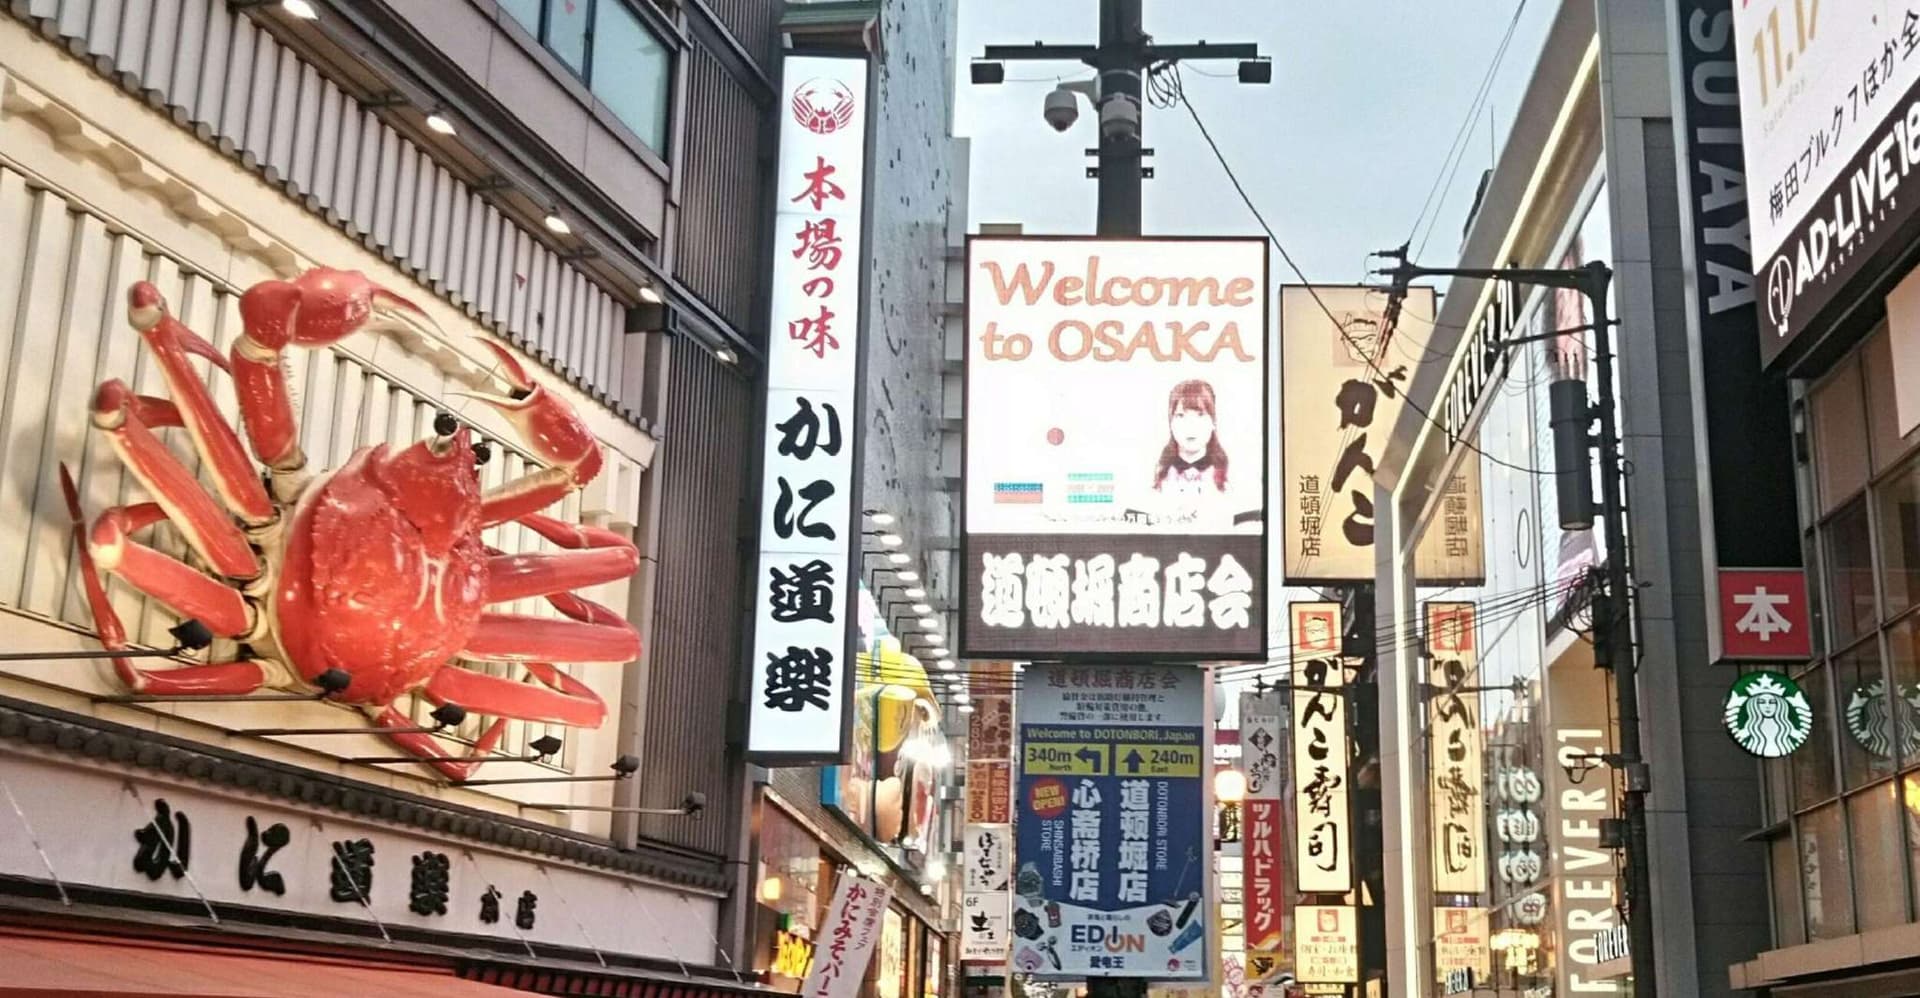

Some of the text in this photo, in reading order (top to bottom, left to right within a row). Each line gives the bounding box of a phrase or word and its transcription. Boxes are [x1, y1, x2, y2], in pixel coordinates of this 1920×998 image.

[789, 156, 845, 360] 本場の味
[979, 256, 1255, 307] Welcome
[980, 320, 1255, 362] to OSAKA
[1300, 475, 1320, 556] 道頓堀店
[981, 552, 1253, 629] 道頓堀商店会
[1733, 586, 1792, 641] 本
[1048, 667, 1181, 690] 道頓堀商店会
[1027, 728, 1077, 739] Welcome
[1080, 729, 1092, 739] to
[1028, 748, 1072, 763] 340m
[1049, 764, 1072, 772] North
[1151, 749, 1194, 765] 240m
[1299, 657, 1343, 872] がんこ寿司
[1034, 785, 1060, 799] NEW
[1040, 819, 1052, 851] STORE
[1155, 781, 1169, 870] DOTONBORI STORE
[1252, 803, 1275, 931] ツルハドラッグ
[965, 896, 979, 907] 6F
[1561, 787, 1618, 994] FOREVER
[1071, 924, 1145, 953] EDION
